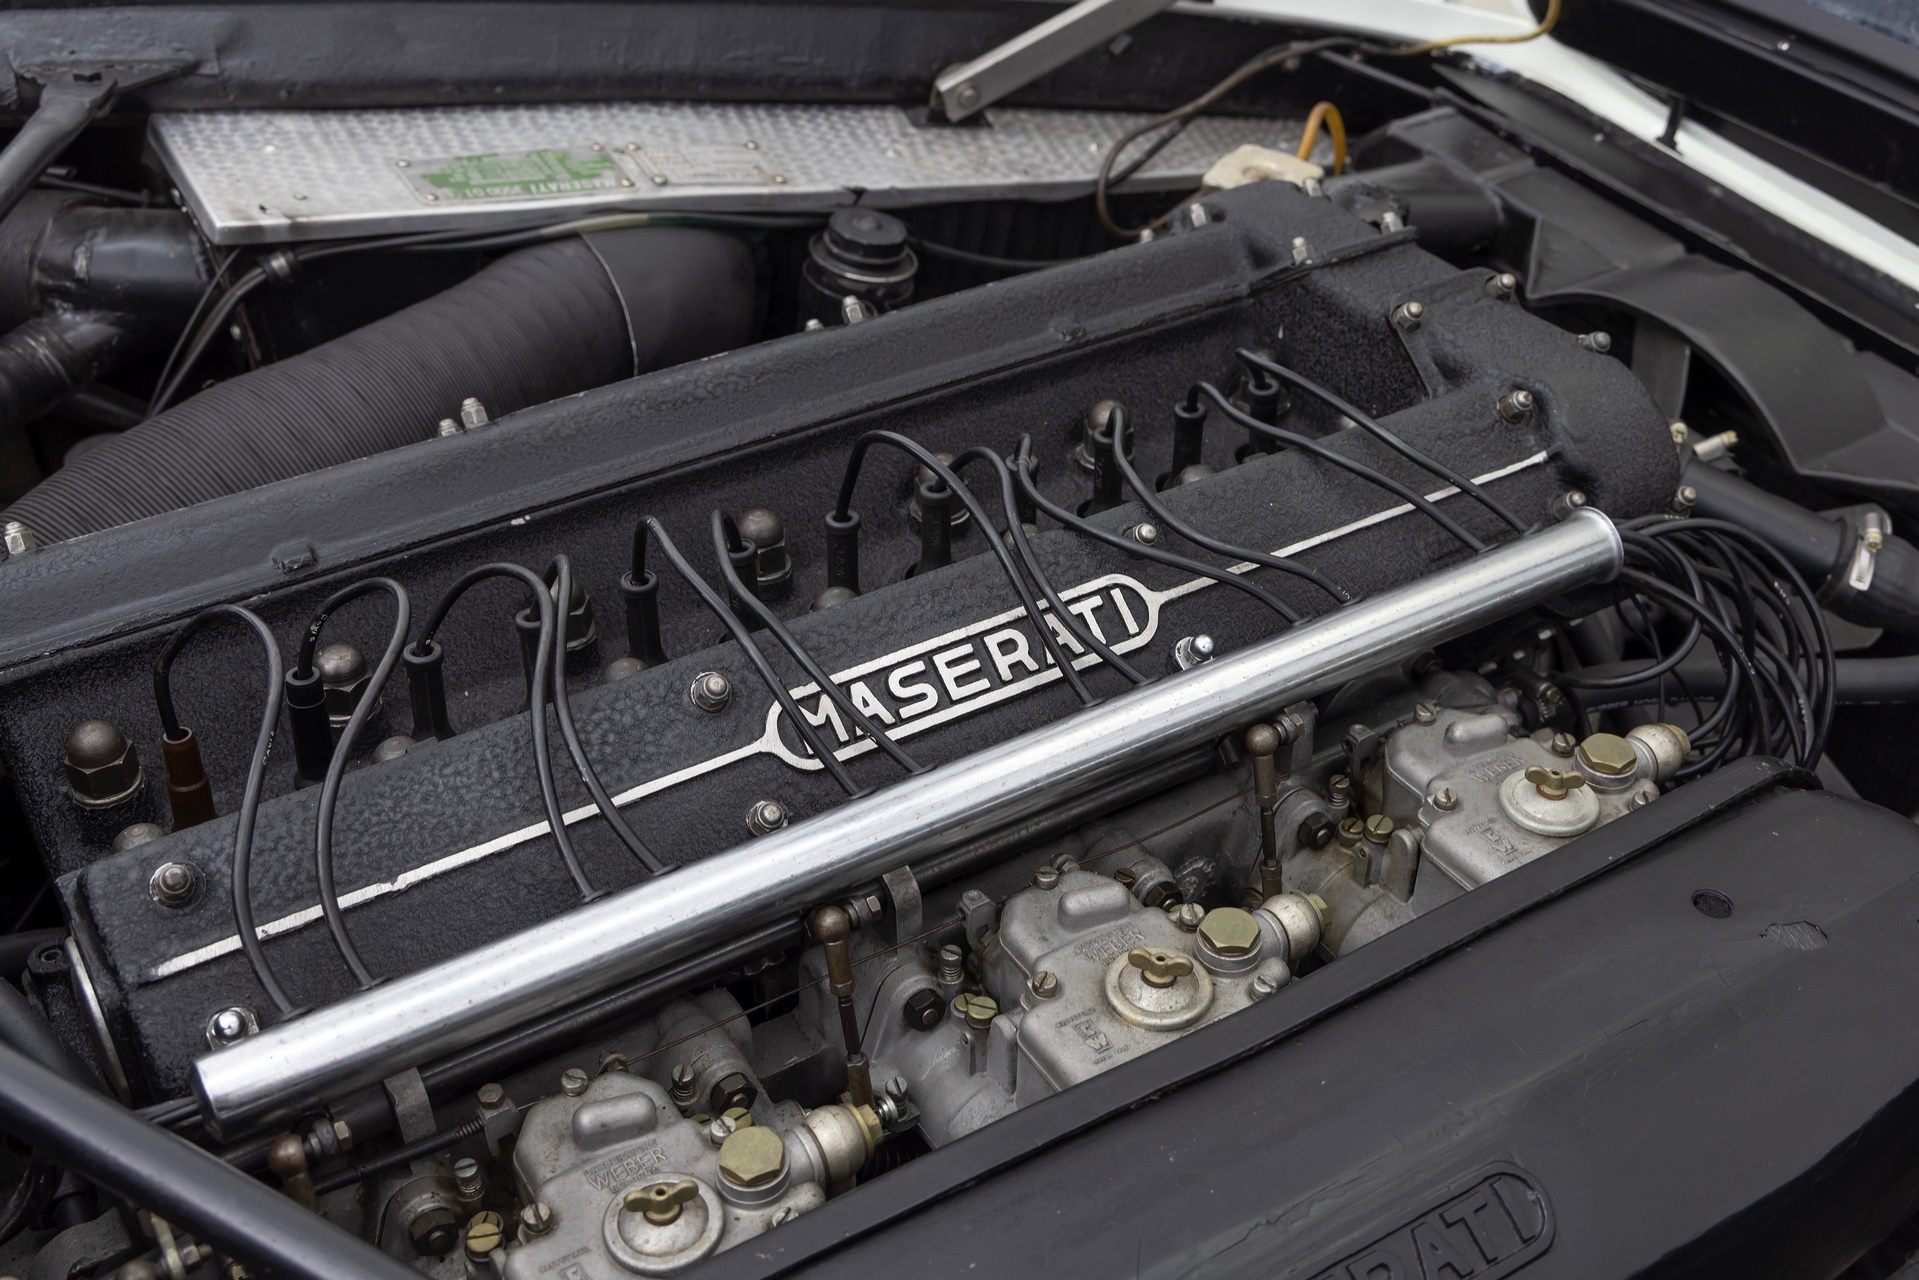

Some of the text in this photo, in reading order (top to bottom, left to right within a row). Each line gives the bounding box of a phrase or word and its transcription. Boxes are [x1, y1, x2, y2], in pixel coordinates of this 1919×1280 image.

[797, 588, 1139, 755] MASERATI
[1470, 756, 1526, 783] WEBER
[1080, 929, 1146, 963] WEBER
[587, 1146, 668, 1191] WEBER
